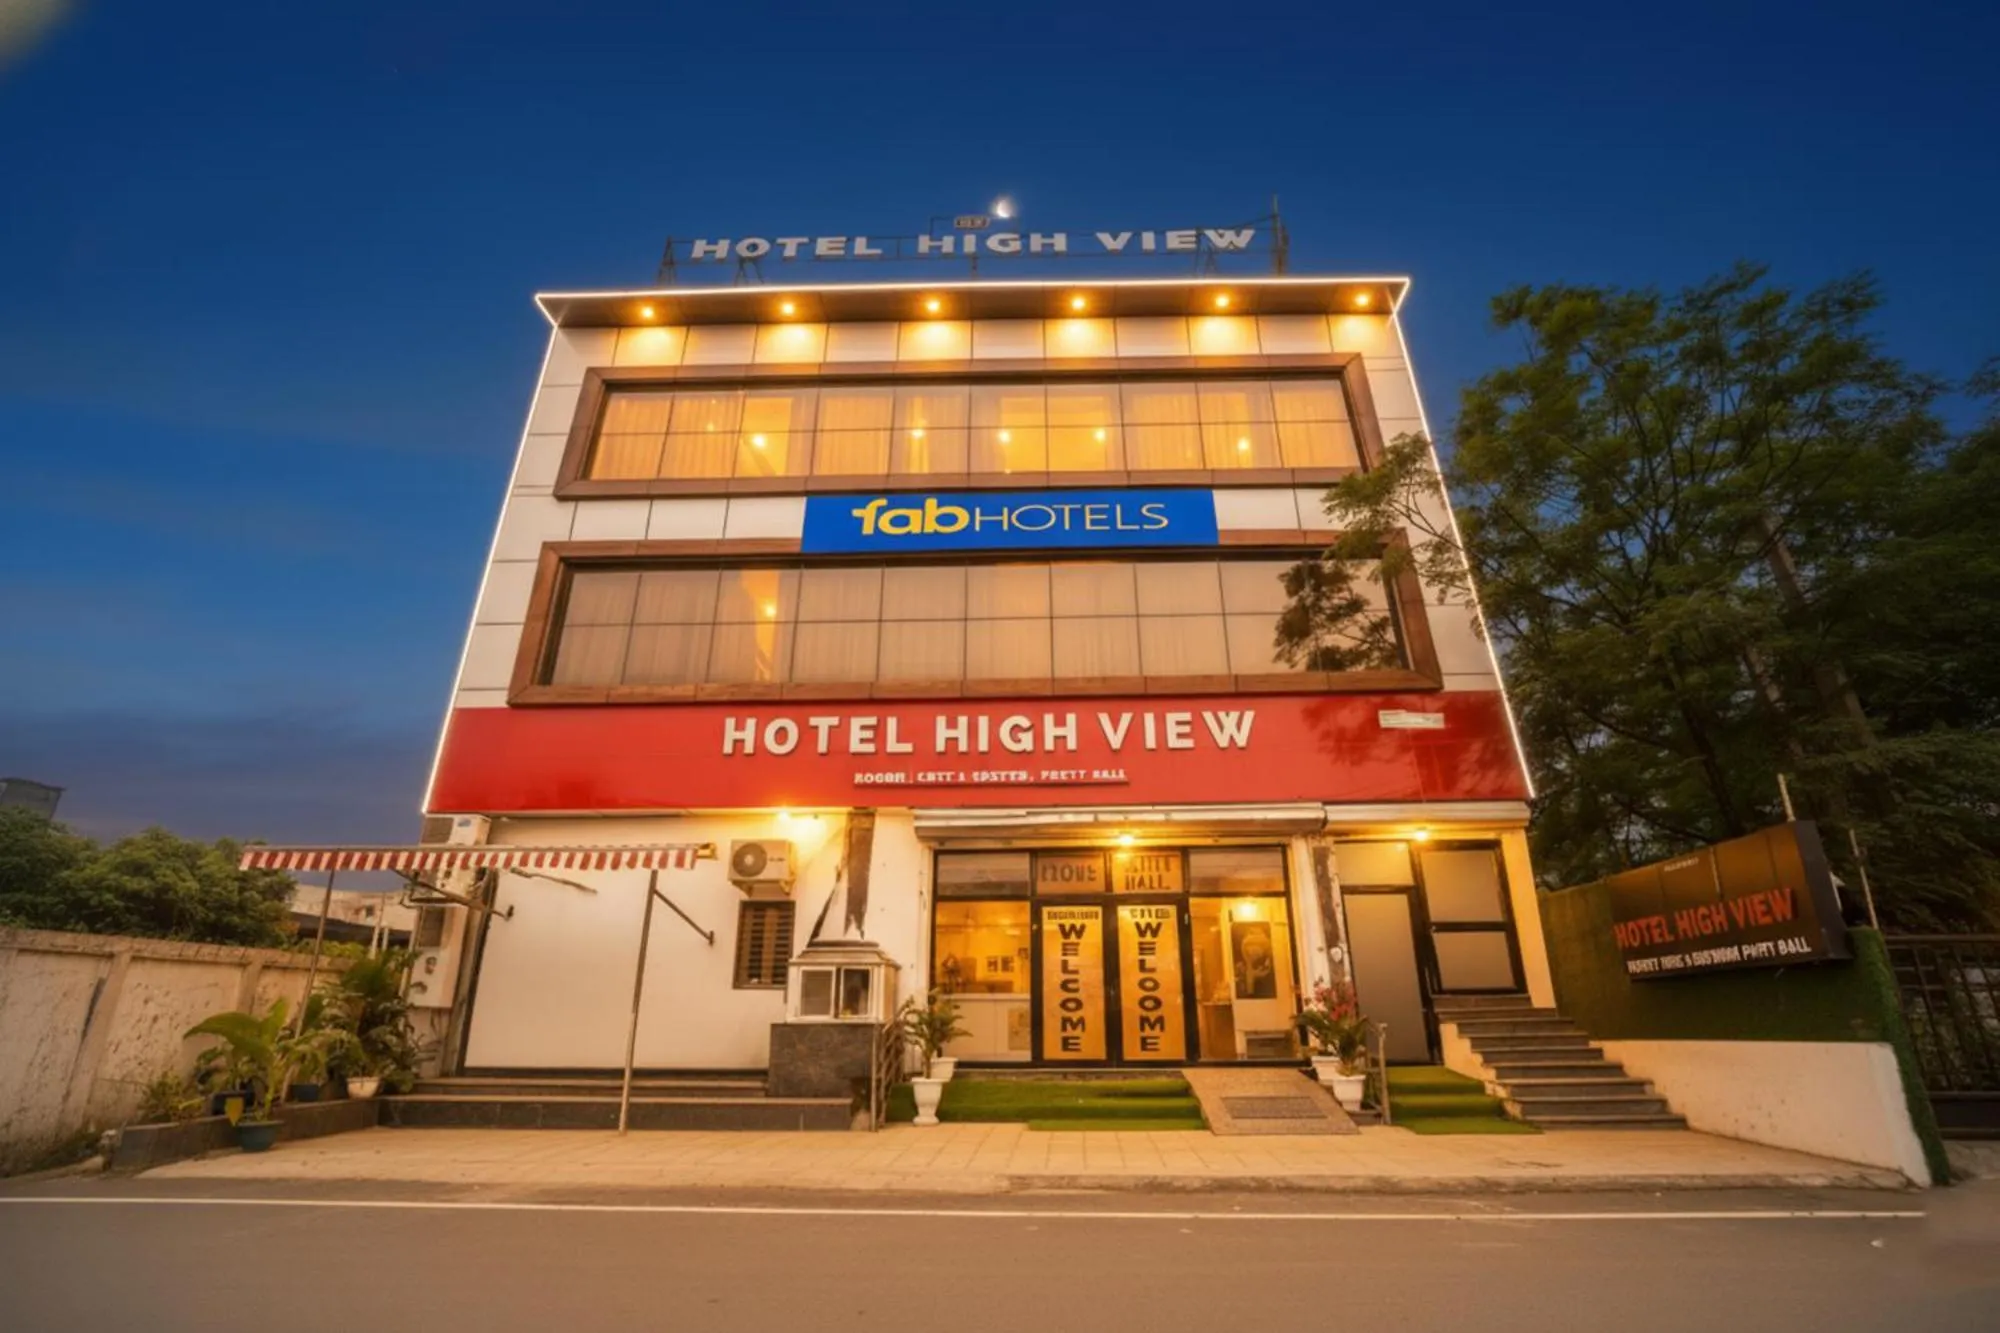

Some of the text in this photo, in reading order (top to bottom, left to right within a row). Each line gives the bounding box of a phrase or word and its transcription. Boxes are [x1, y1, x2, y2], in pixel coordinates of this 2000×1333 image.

[691, 229, 1255, 259] HOTEL HIGH VIEW
[722, 710, 1256, 756] HOTEL HIGH VIEW
[1614, 888, 1793, 948] HOTEL HIGH VIEW
[1058, 923, 1086, 1052] WELCOME
